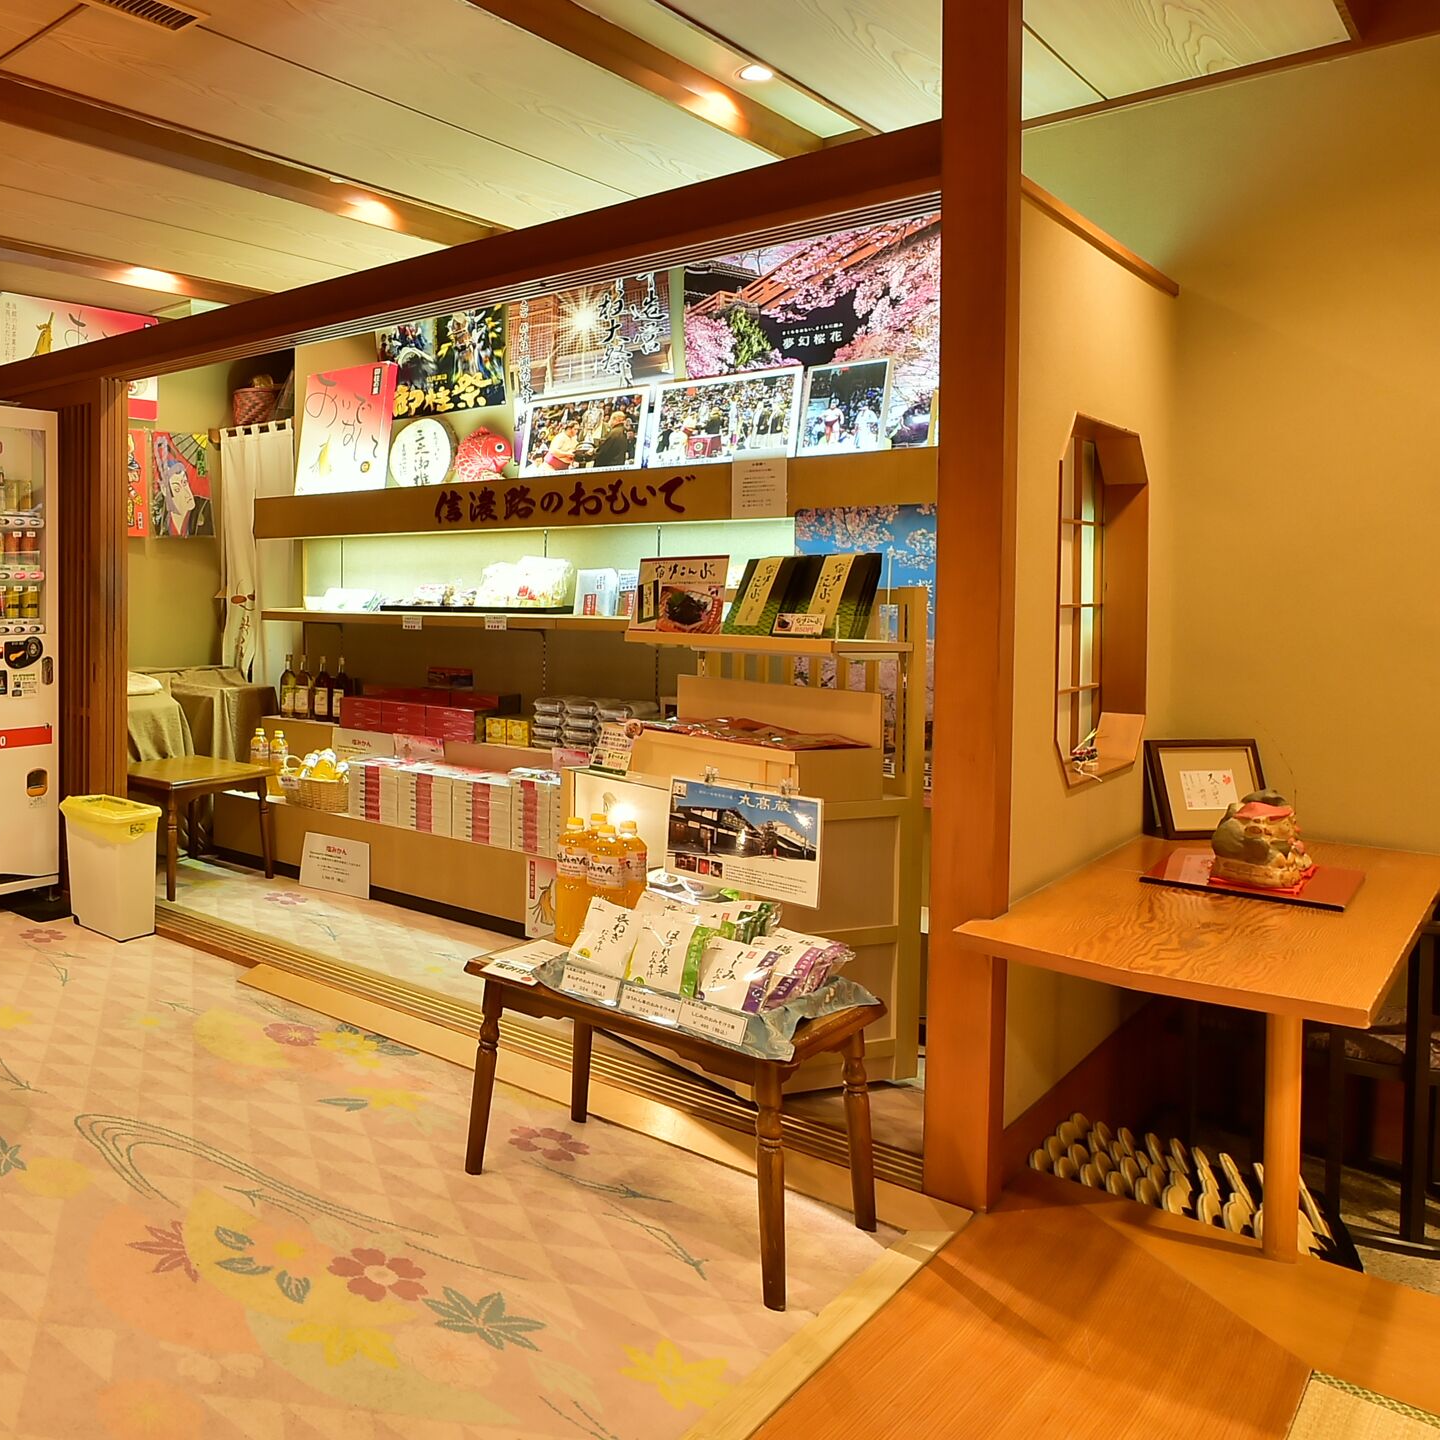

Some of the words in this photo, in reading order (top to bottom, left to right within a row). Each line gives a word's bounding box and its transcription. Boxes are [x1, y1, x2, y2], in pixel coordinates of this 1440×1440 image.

[782, 330, 843, 350] 夢幻桜花
[434, 474, 696, 523] 信濃路のおもいで
[738, 793, 792, 815] 丸高蔵
[611, 914, 629, 943] 長ねぎ
[656, 930, 680, 977] ほうれん草
[723, 951, 743, 981] しじみ
